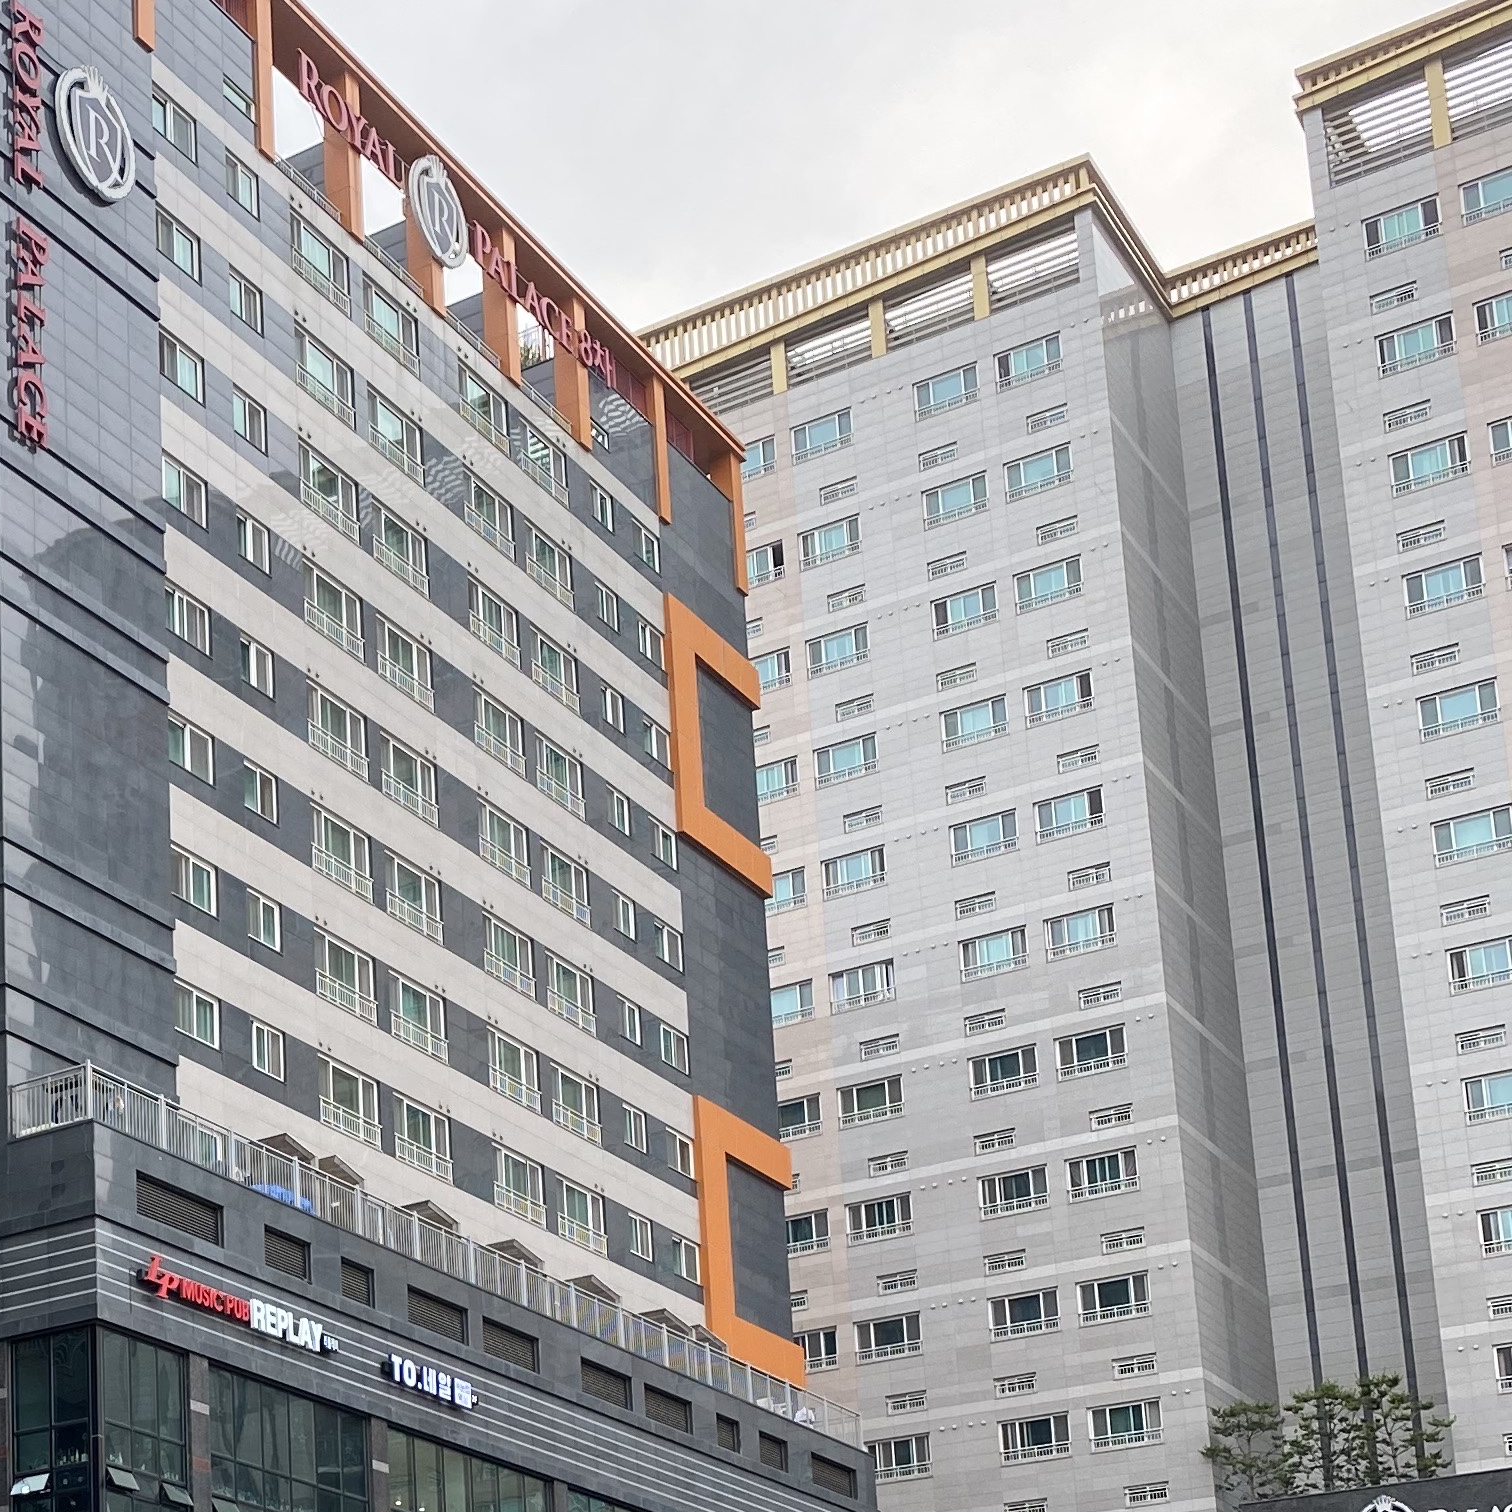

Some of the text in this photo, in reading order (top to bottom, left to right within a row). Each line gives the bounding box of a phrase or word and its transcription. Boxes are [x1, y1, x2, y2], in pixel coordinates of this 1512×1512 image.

[10, 0, 49, 447] ROYAL PALACE
[296, 48, 405, 191] ROYAL
[471, 219, 574, 354] PALACE
[180, 1277, 223, 1312] MUSIC
[224, 1292, 251, 1323] PUB
[250, 1298, 323, 1352] REPLAY
